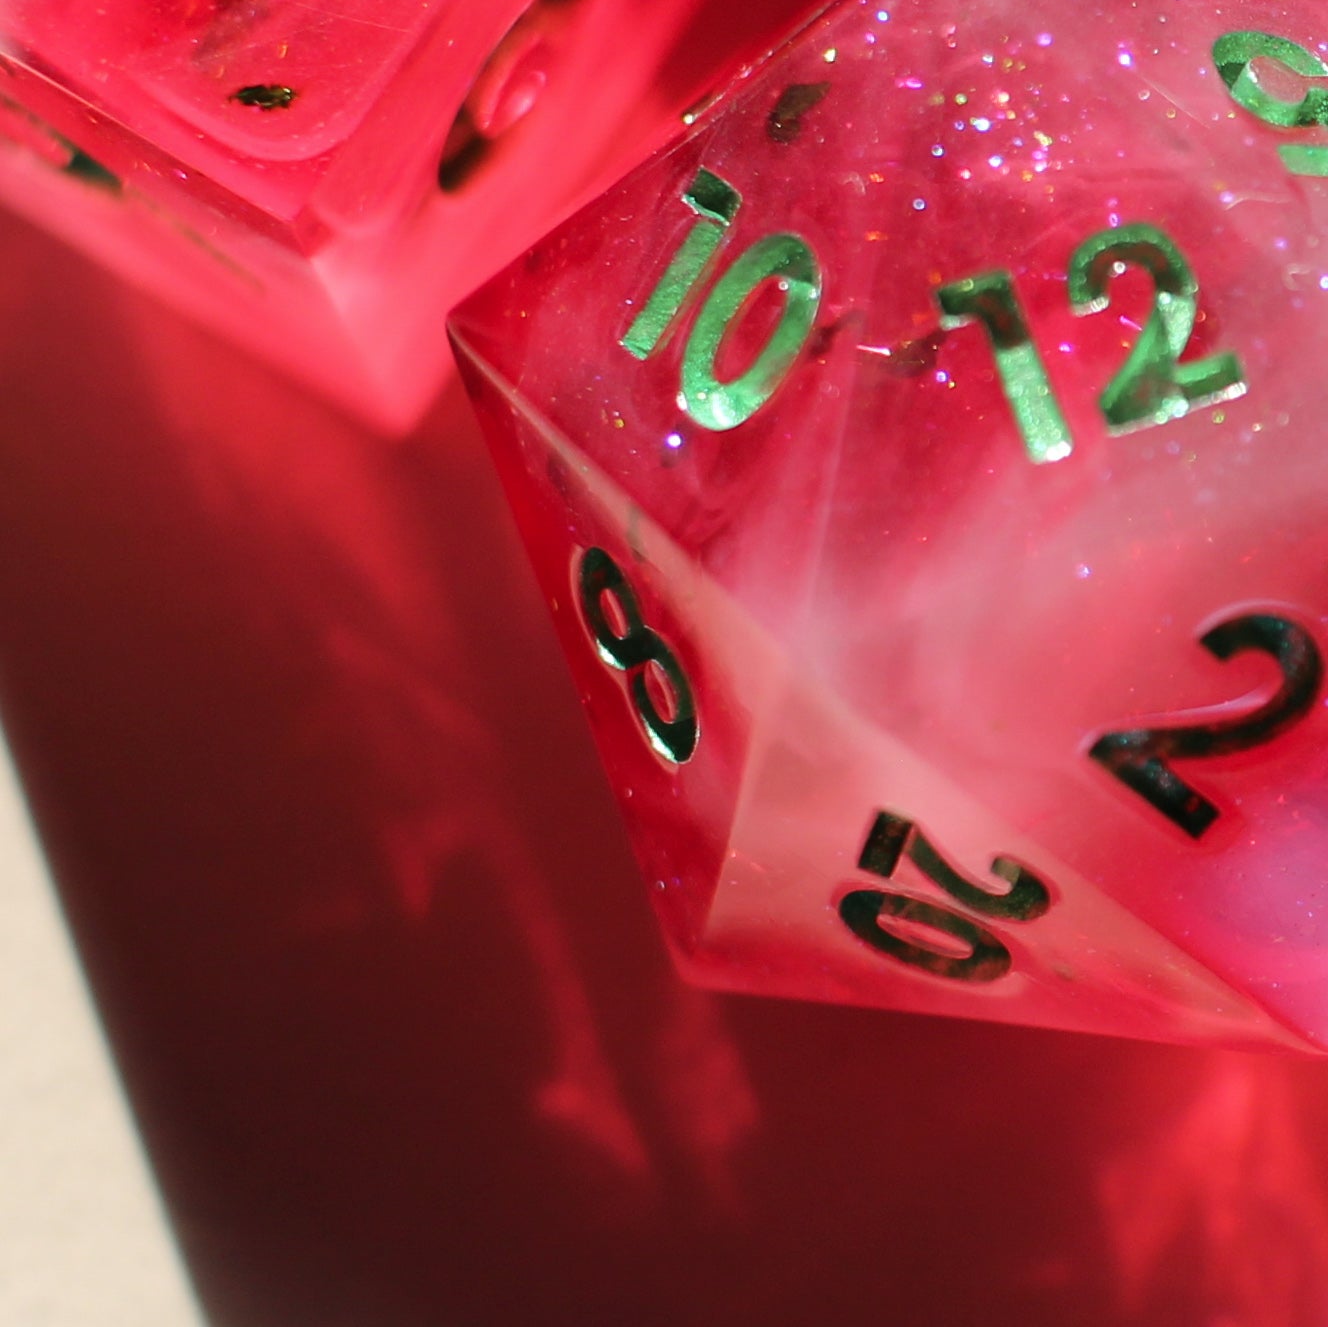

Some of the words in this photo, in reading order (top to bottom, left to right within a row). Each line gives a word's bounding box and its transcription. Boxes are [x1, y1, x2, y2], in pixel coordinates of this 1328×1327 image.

[619, 167, 824, 432] 10
[936, 223, 1248, 465] 12
[572, 545, 704, 767] 8
[1086, 610, 1328, 842] 2
[834, 808, 1052, 984] 20
